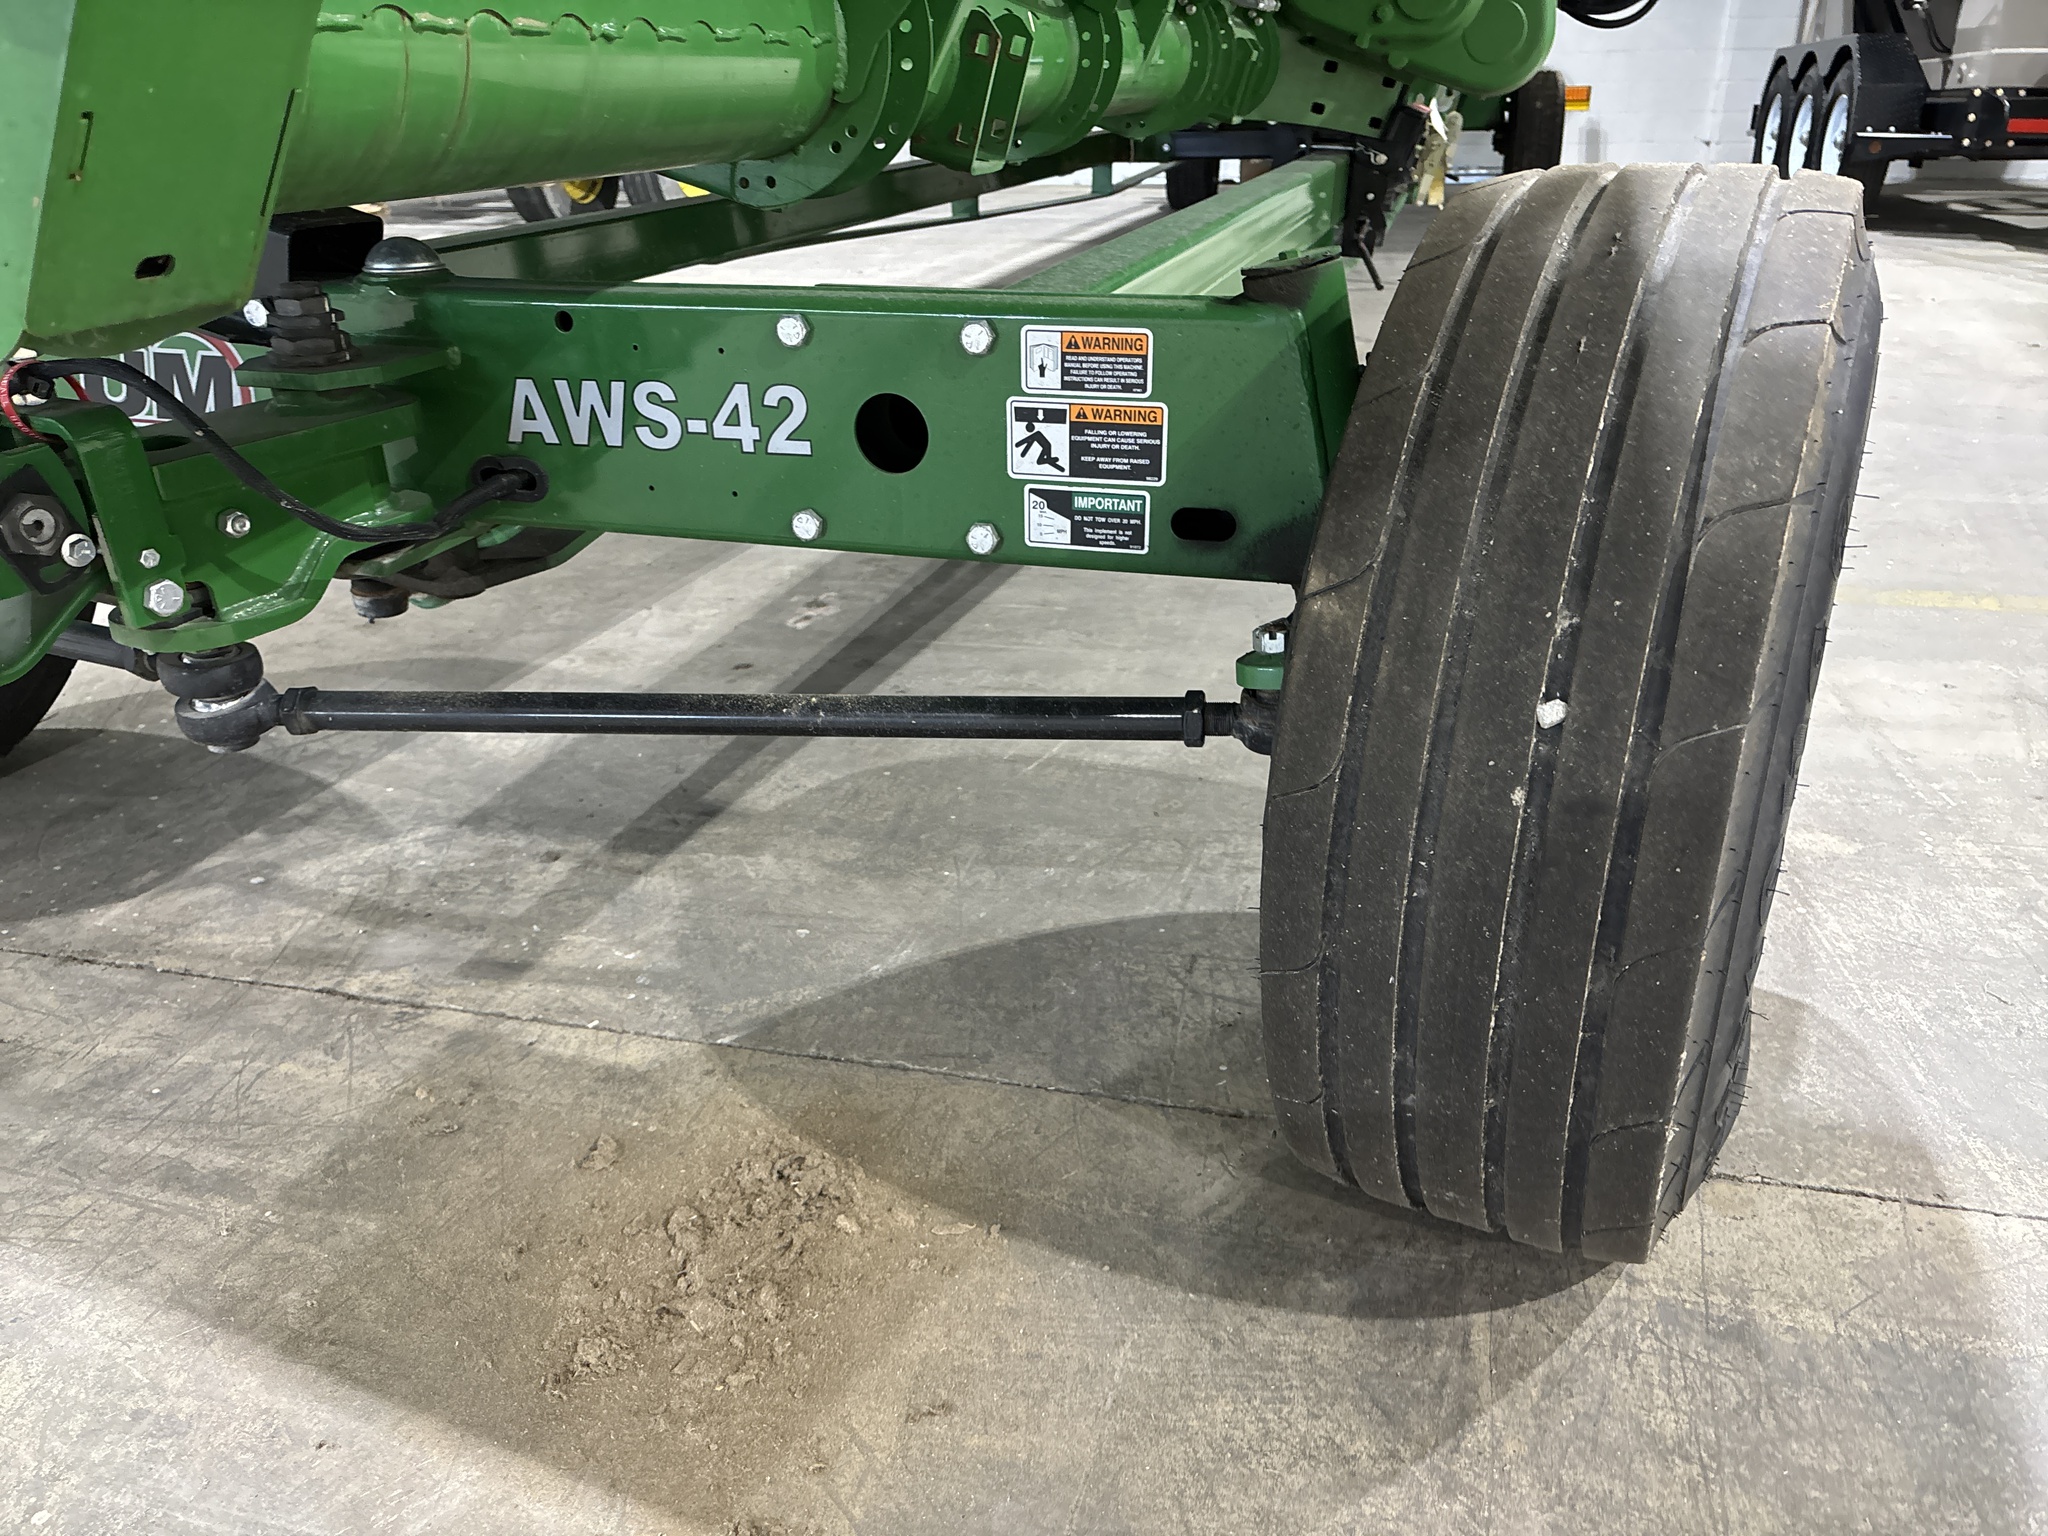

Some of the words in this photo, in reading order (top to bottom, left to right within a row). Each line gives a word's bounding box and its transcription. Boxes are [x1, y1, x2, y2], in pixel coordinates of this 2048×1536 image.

[1081, 336, 1144, 351] WARNING
[506, 377, 813, 456] AWS-42
[1091, 408, 1157, 422] WARNING
[1032, 500, 1045, 510] 20
[1074, 496, 1142, 512] IMPORTANT
